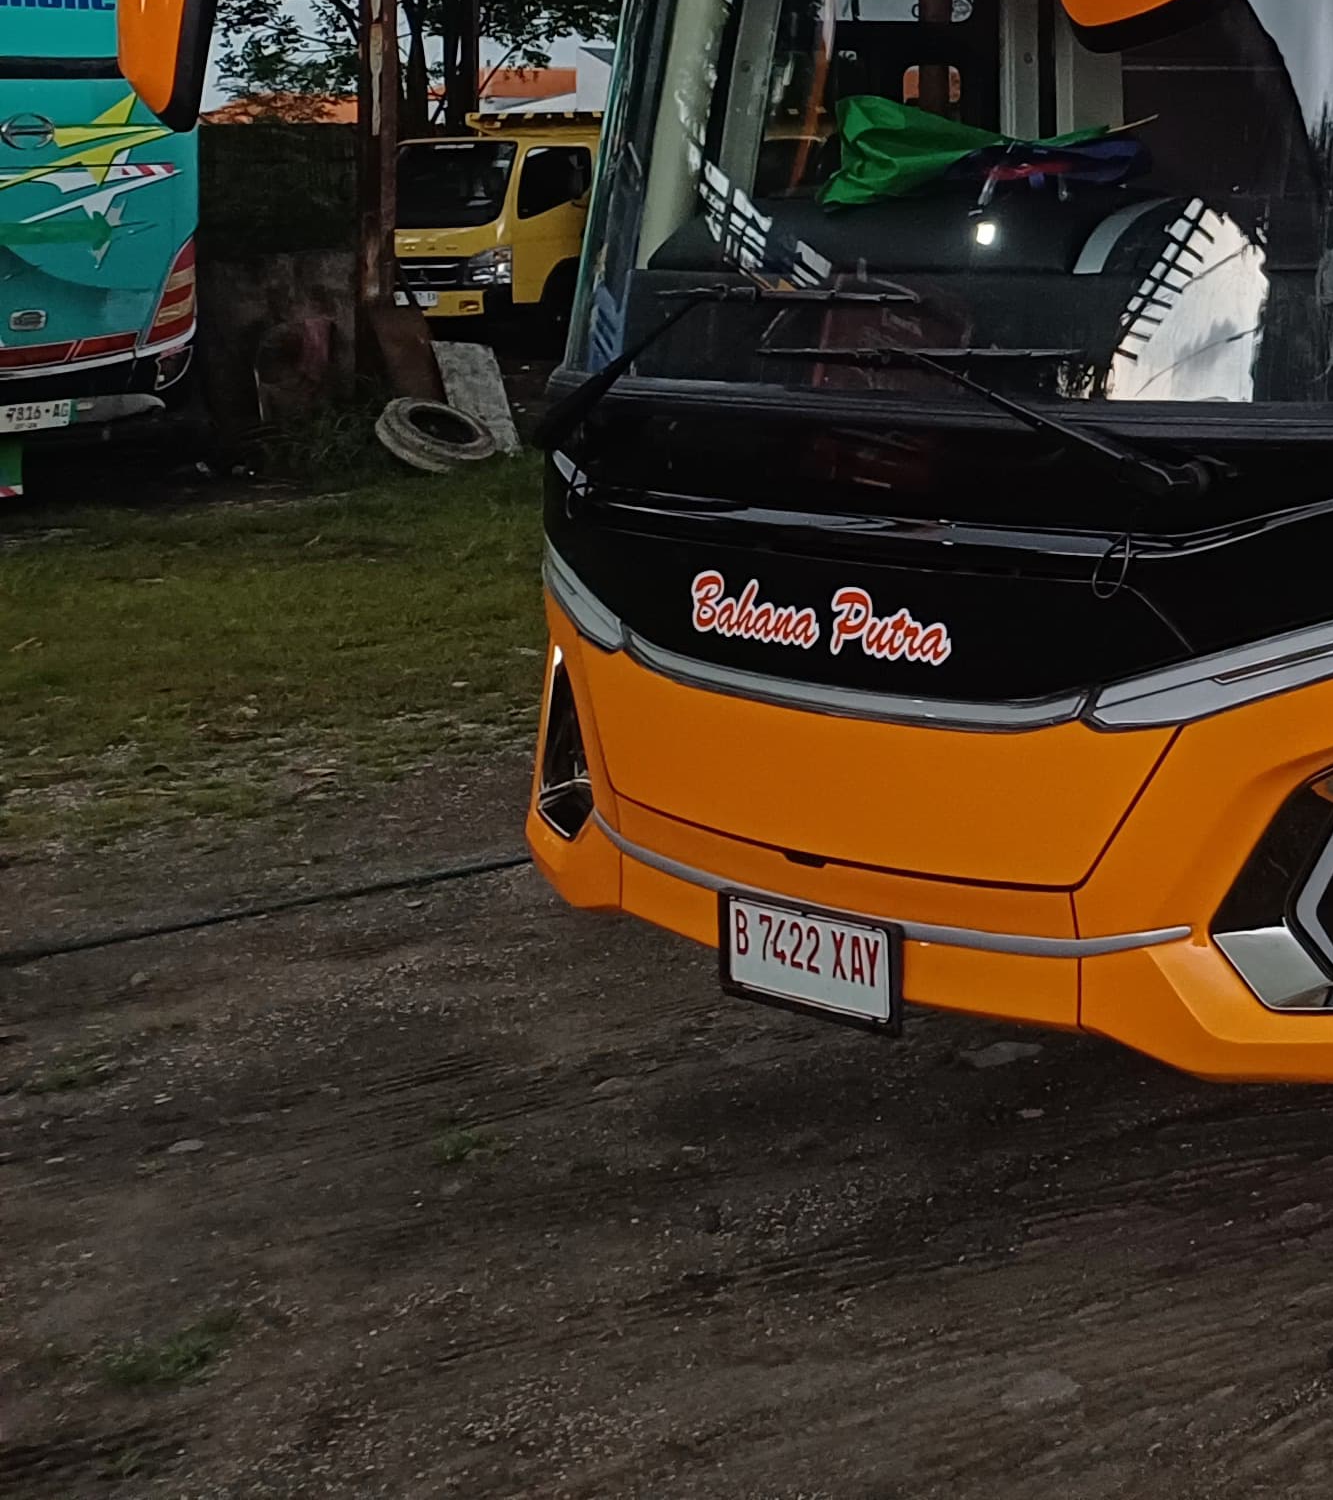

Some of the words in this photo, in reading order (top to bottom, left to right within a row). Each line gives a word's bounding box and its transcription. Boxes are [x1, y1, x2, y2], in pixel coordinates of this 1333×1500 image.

[691, 570, 819, 649] Bahana
[830, 586, 951, 666] Putra
[735, 908, 749, 956] B
[759, 913, 821, 976] 7422
[831, 929, 880, 988] XAY
